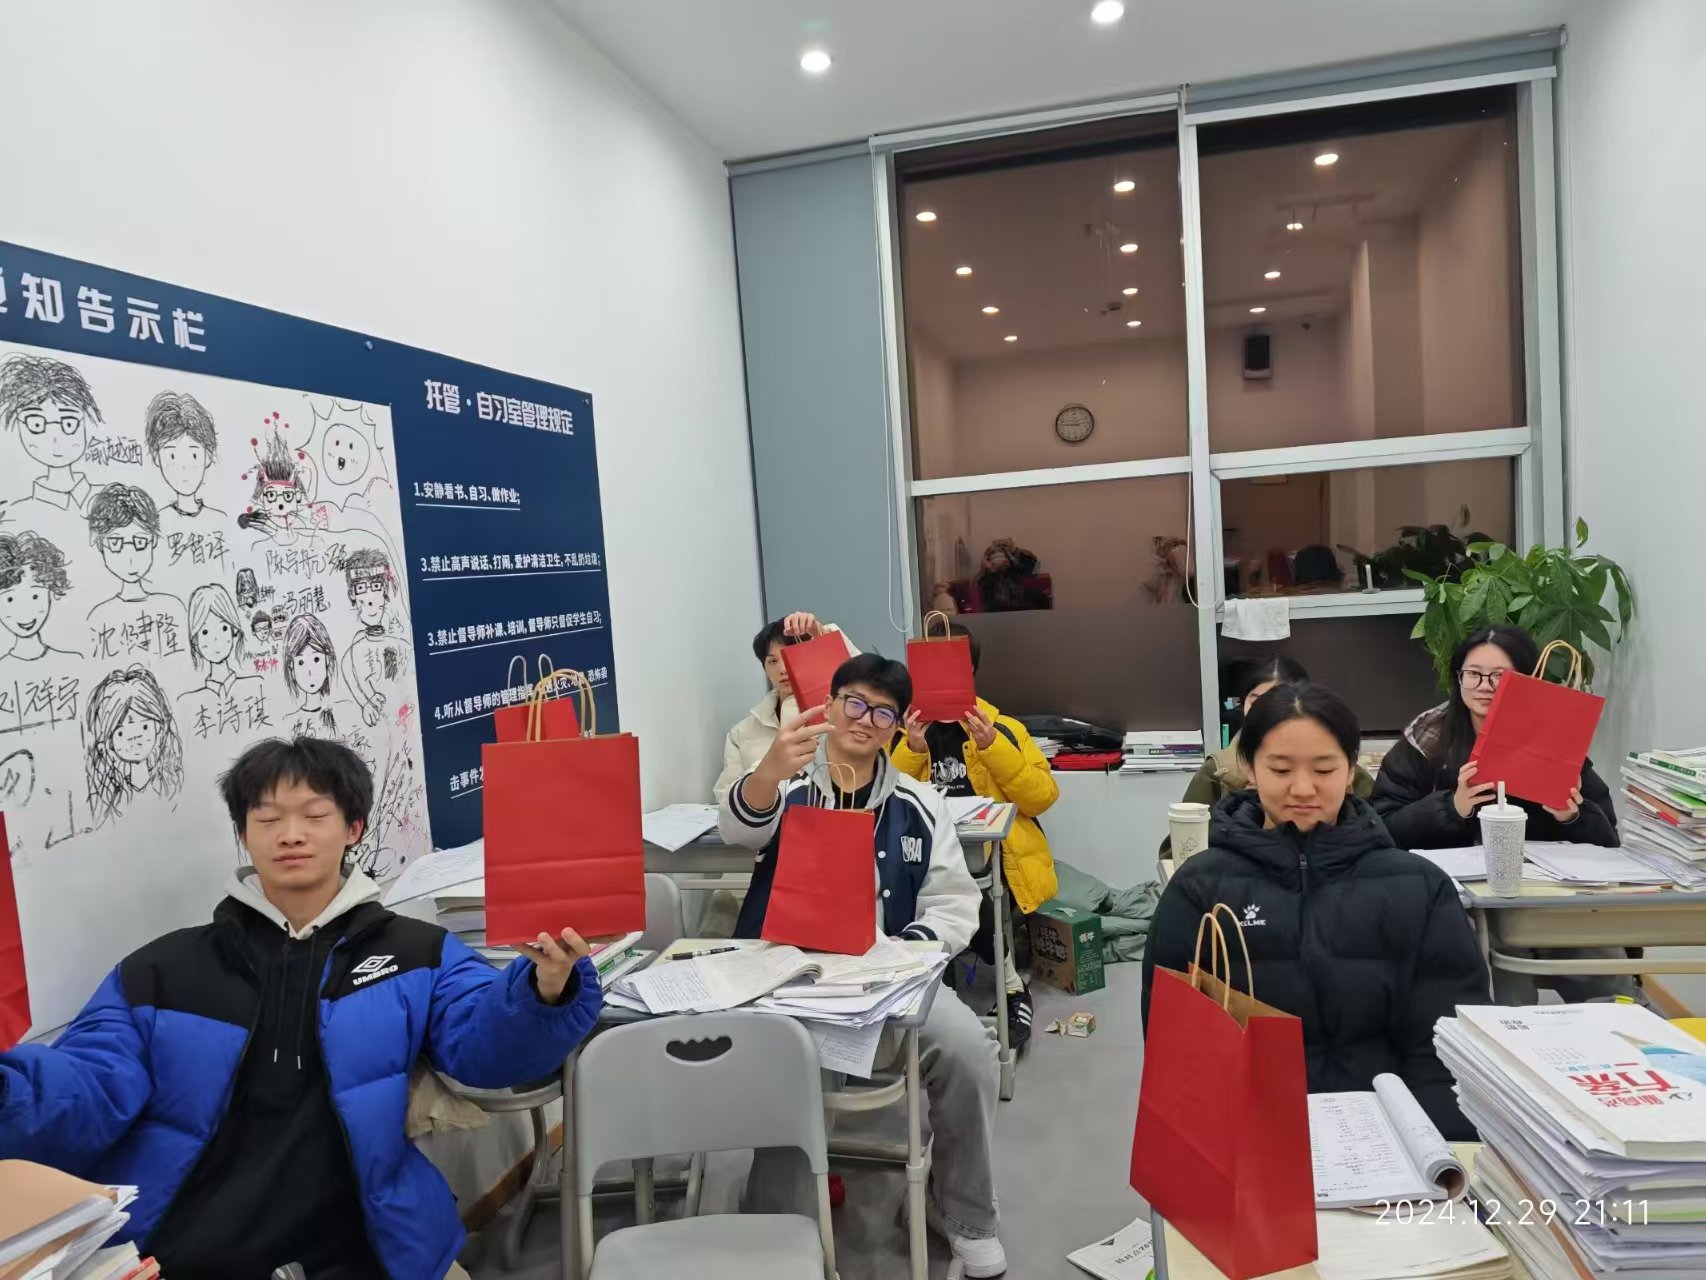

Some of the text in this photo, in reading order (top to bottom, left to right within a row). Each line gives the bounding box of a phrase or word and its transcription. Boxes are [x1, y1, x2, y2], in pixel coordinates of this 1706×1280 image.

[0, 267, 207, 352] 知告示栏
[353, 964, 399, 985] UMBRO
